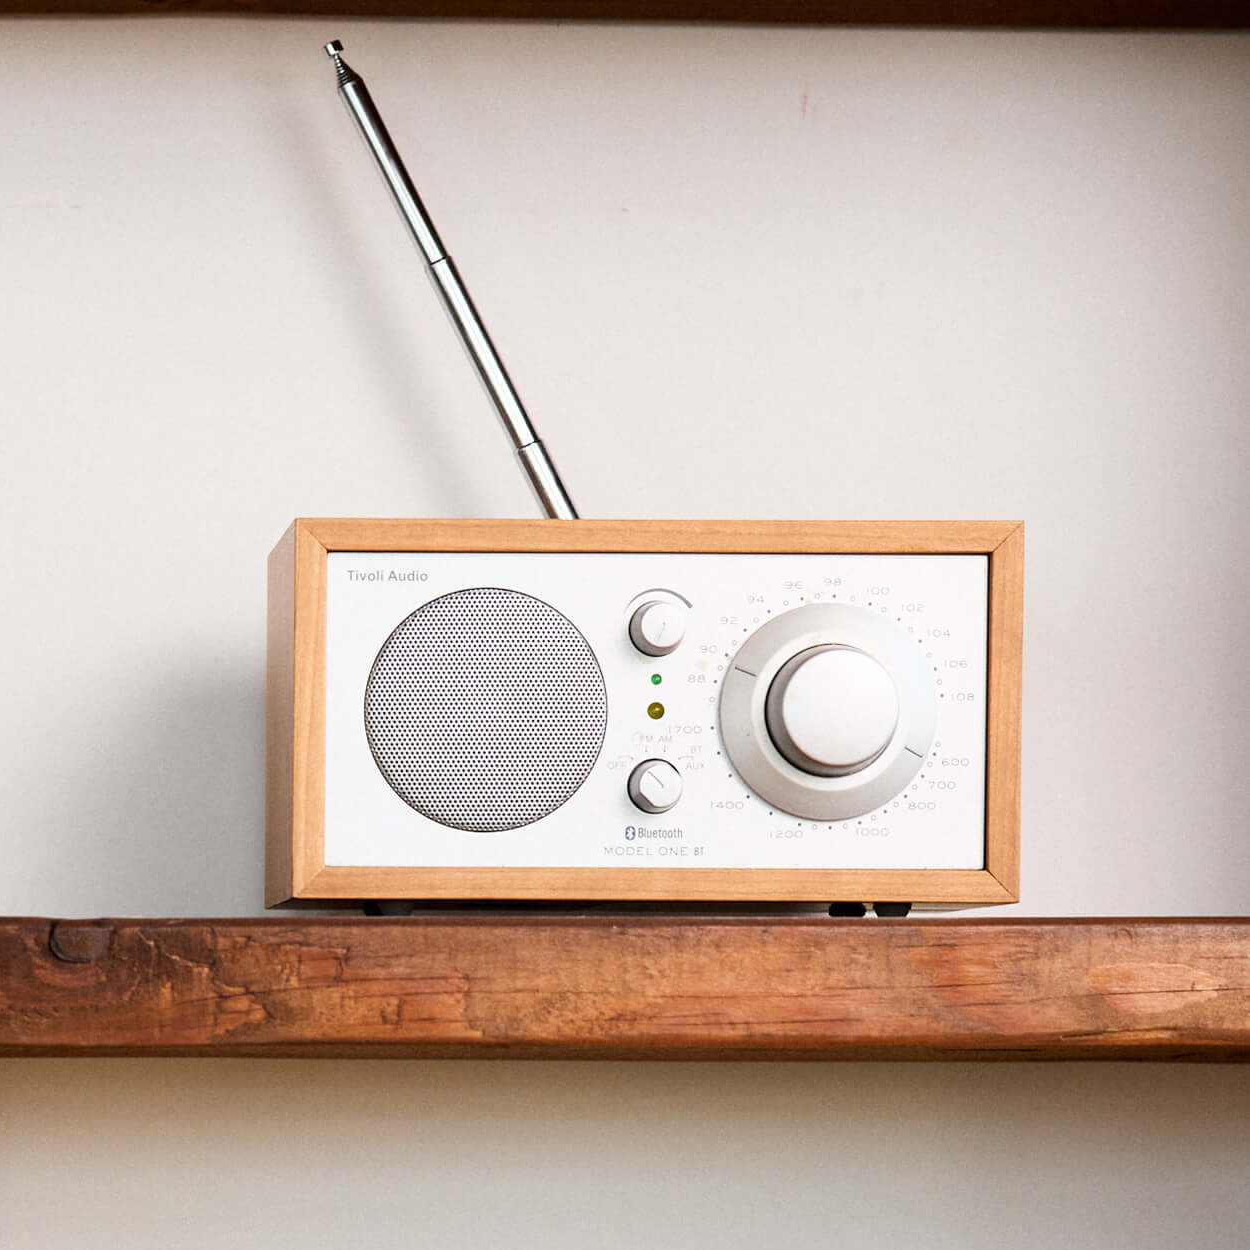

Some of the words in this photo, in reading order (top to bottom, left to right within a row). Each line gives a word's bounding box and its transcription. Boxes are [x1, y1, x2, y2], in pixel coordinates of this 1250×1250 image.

[347, 569, 384, 582] Tivoli
[388, 569, 429, 582] Audio
[824, 577, 842, 587] 98
[867, 586, 890, 595] 100
[901, 603, 925, 612] 102
[928, 629, 951, 638] 104
[944, 660, 968, 669] 106
[951, 692, 975, 702] 108
[942, 757, 970, 768] 600
[928, 780, 956, 790] 700
[908, 801, 936, 811] 800
[638, 827, 683, 838] Bluetooth
[604, 847, 654, 856] MODEL
[658, 847, 688, 856] ONE
[694, 847, 704, 856] BT
